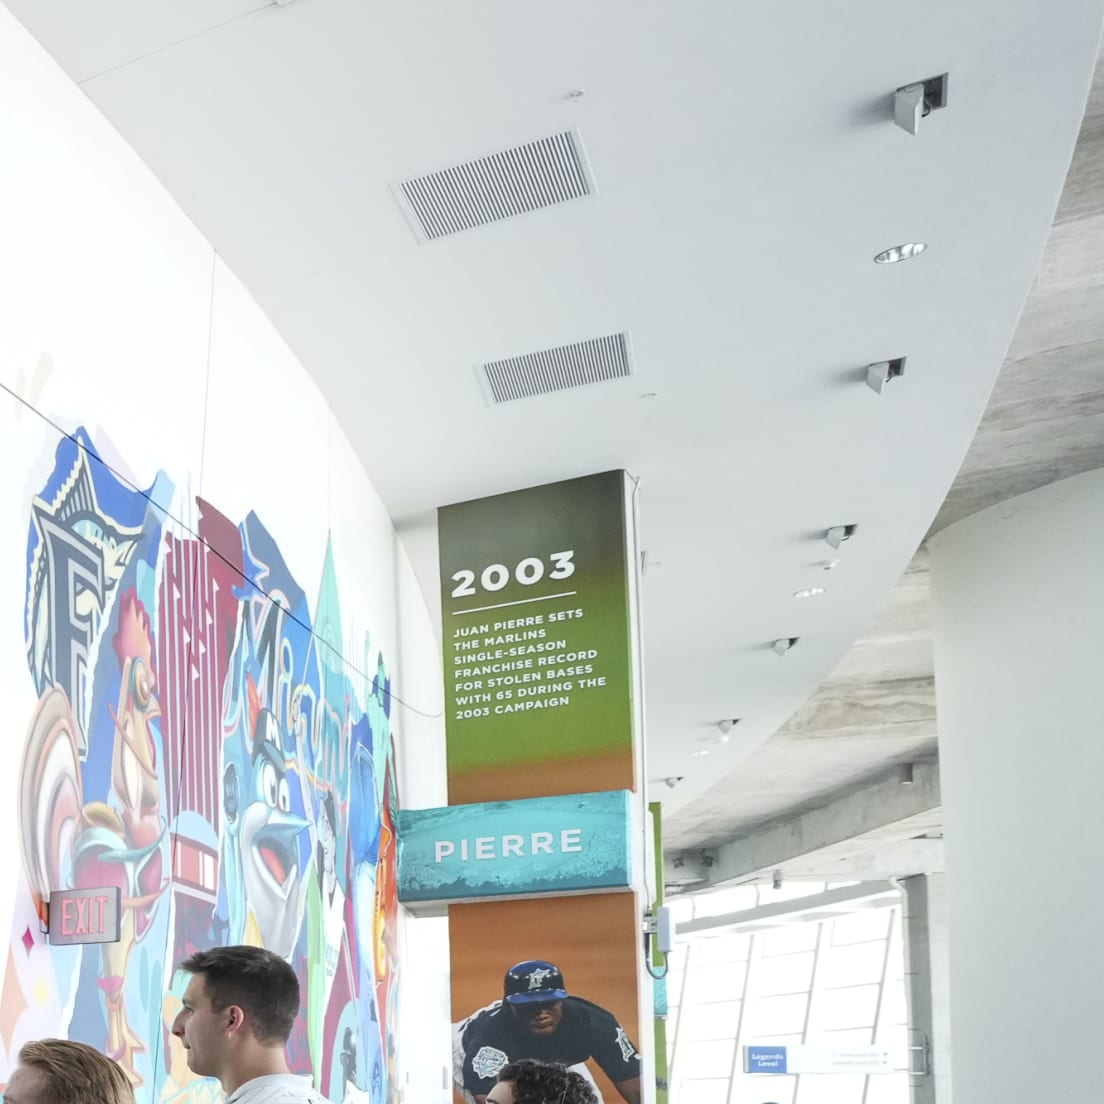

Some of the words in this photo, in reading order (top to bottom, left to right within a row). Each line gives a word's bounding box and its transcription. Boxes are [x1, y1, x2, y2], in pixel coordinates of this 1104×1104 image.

[450, 550, 577, 599] 2003
[452, 624, 489, 638] JUAN
[494, 615, 544, 631] PIERRE
[548, 608, 584, 622] SETS
[453, 640, 480, 651] THE
[484, 629, 546, 647] MARLINS
[454, 640, 567, 665] SINGLE-SEASON
[454, 659, 533, 678] FRANCHISE
[538, 649, 598, 666] RECORD
[455, 681, 483, 692] FOR
[487, 672, 542, 688] STOLEN
[547, 664, 593, 679] BASES
[456, 693, 491, 706] WITH
[496, 690, 513, 700] 65
[518, 682, 573, 697] DURING
[578, 677, 607, 689] THE
[456, 707, 490, 720] 2003
[494, 696, 570, 714] CAMPAIGN
[434, 828, 584, 864] PIERRE
[61, 896, 109, 936] EXIT
[751, 1053, 784, 1061] Legends
